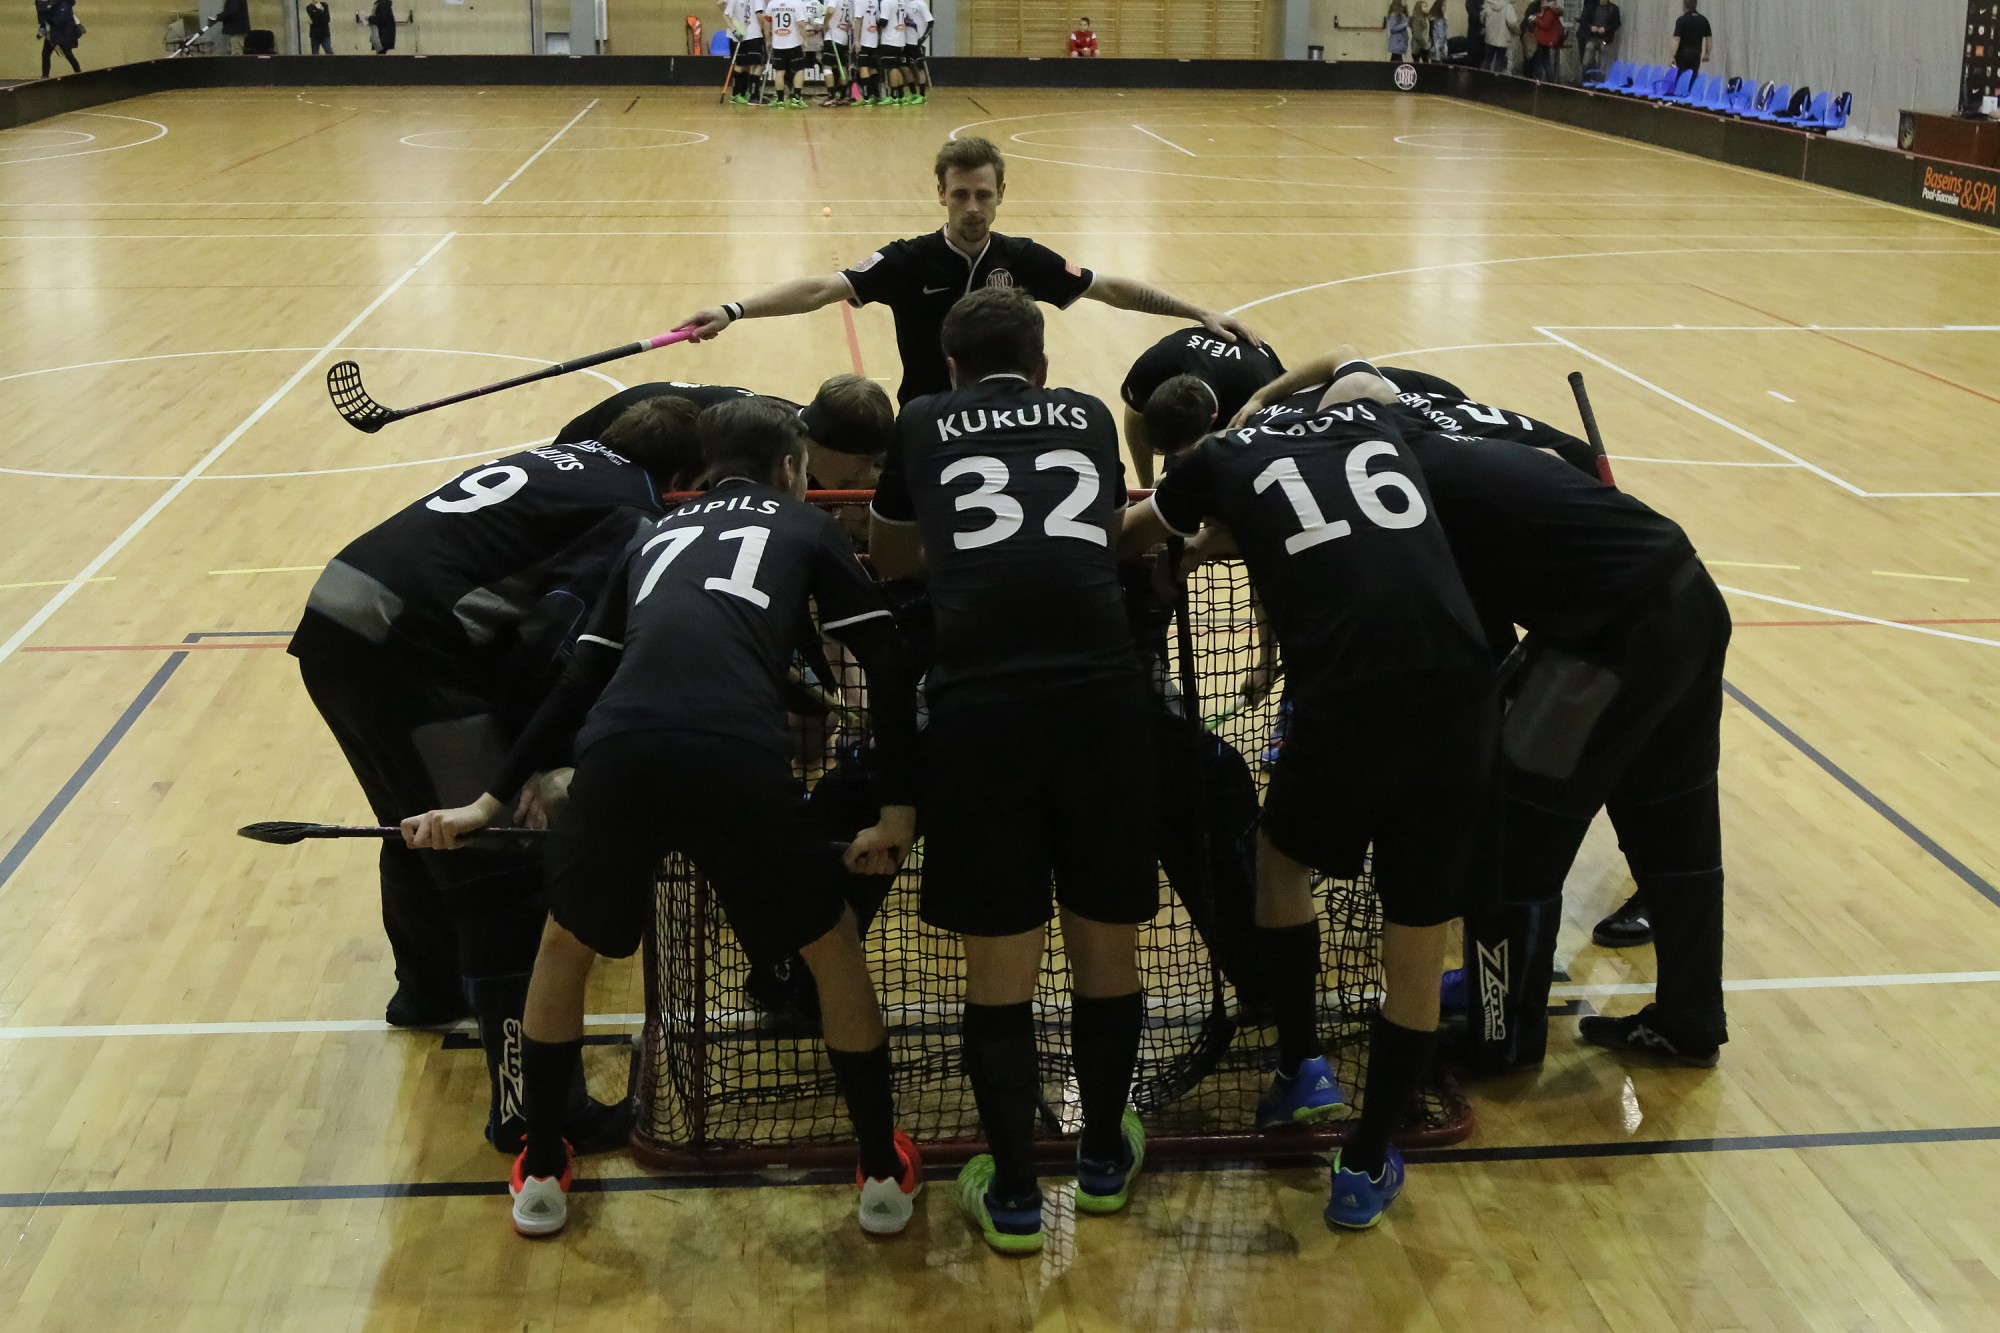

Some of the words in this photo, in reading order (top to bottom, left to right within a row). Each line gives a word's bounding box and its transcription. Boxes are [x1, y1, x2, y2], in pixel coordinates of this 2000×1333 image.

[775, 13, 791, 28] 19
[1923, 166, 1963, 193] Baseins
[937, 402, 1088, 442] KUKUKS
[656, 496, 780, 528] PUPILS
[940, 448, 1108, 550] 32
[1253, 440, 1427, 555] 16
[634, 525, 771, 610] 71
